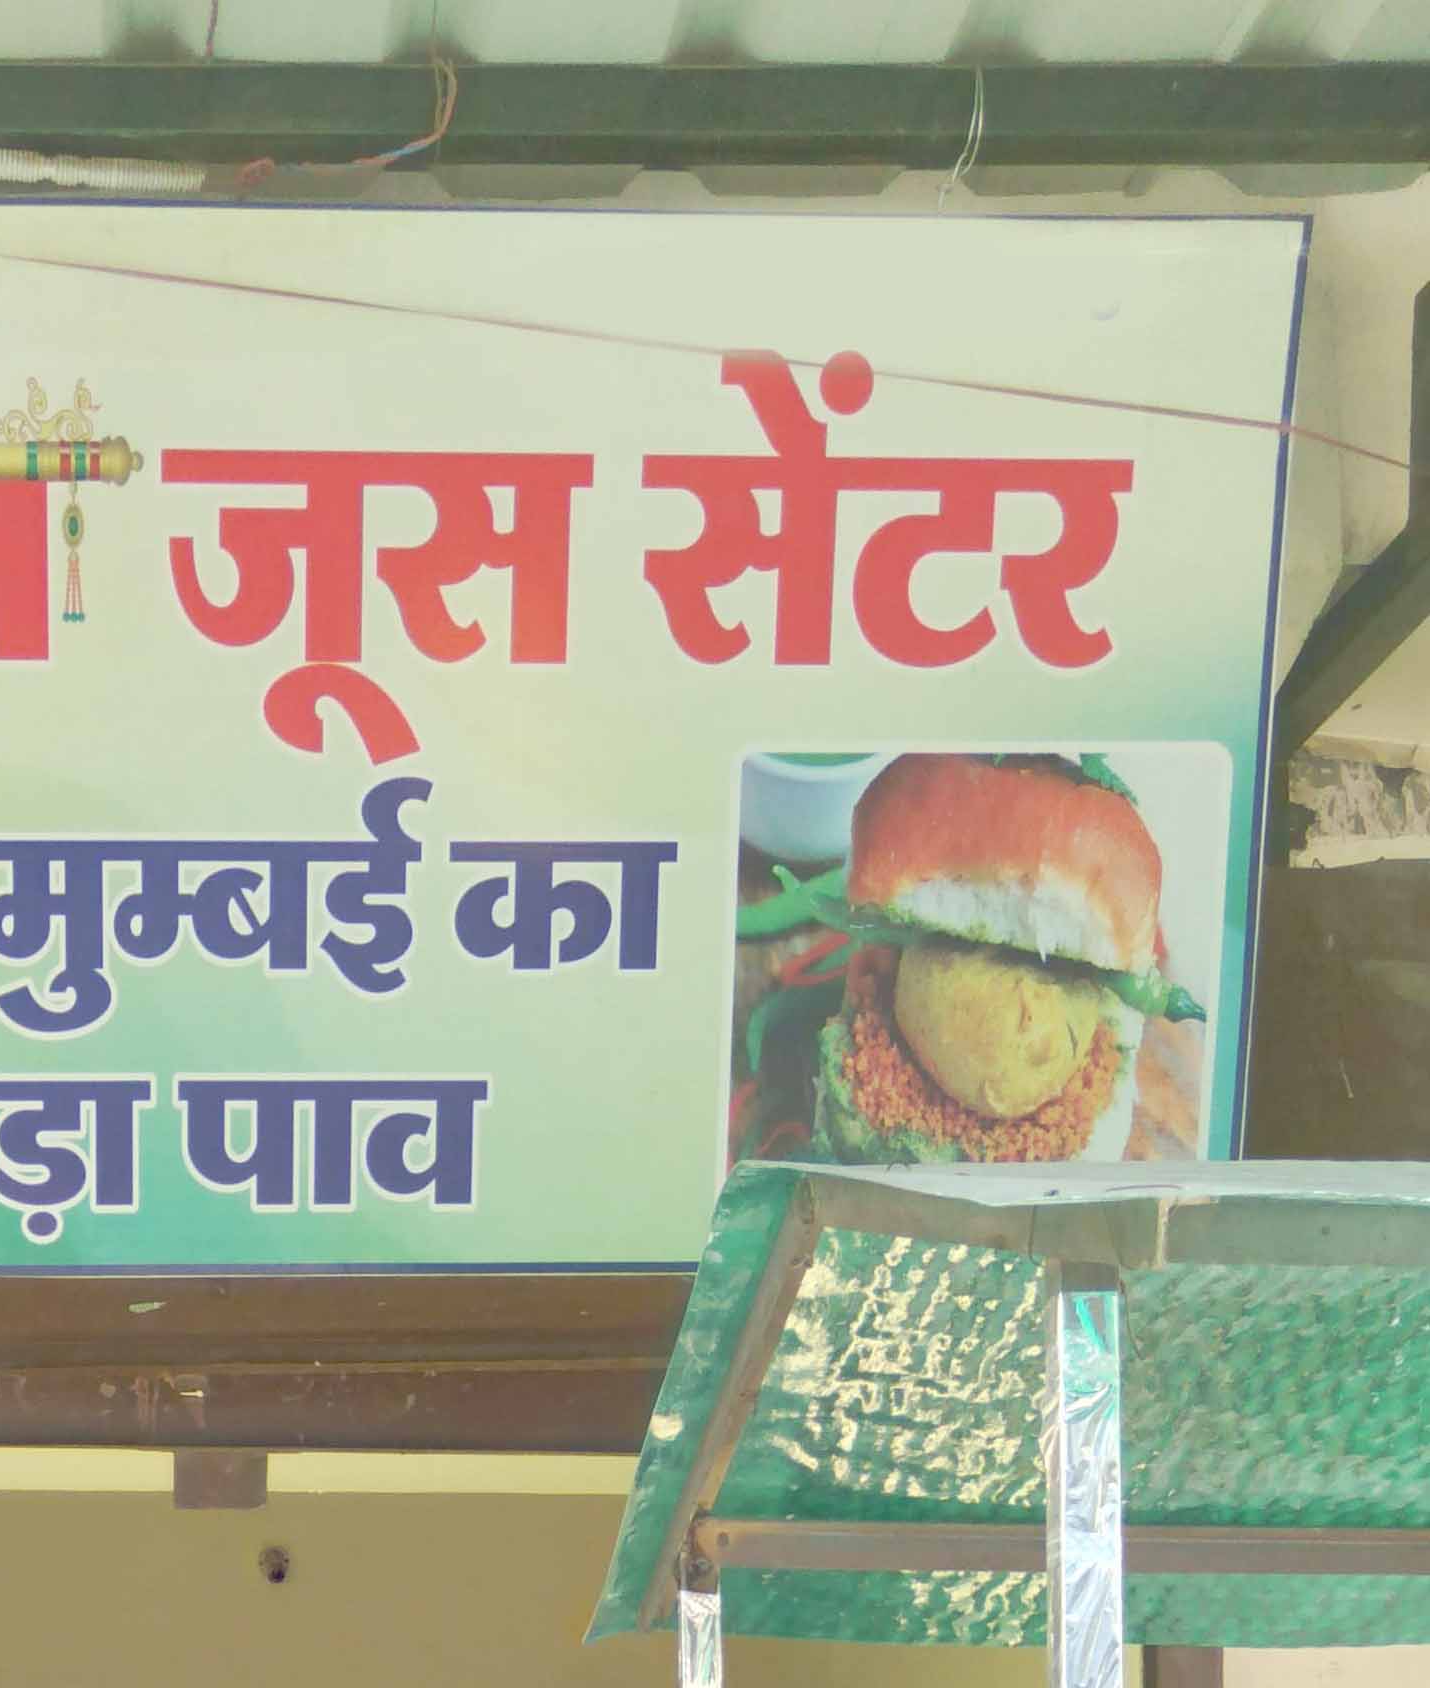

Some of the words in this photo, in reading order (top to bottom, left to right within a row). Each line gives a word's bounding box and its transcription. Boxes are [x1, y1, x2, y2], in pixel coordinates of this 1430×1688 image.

[161, 449, 594, 763] जूस
[641, 349, 1134, 668] सेंटर
[450, 841, 678, 970] का
[178, 1080, 488, 1206] पाव
